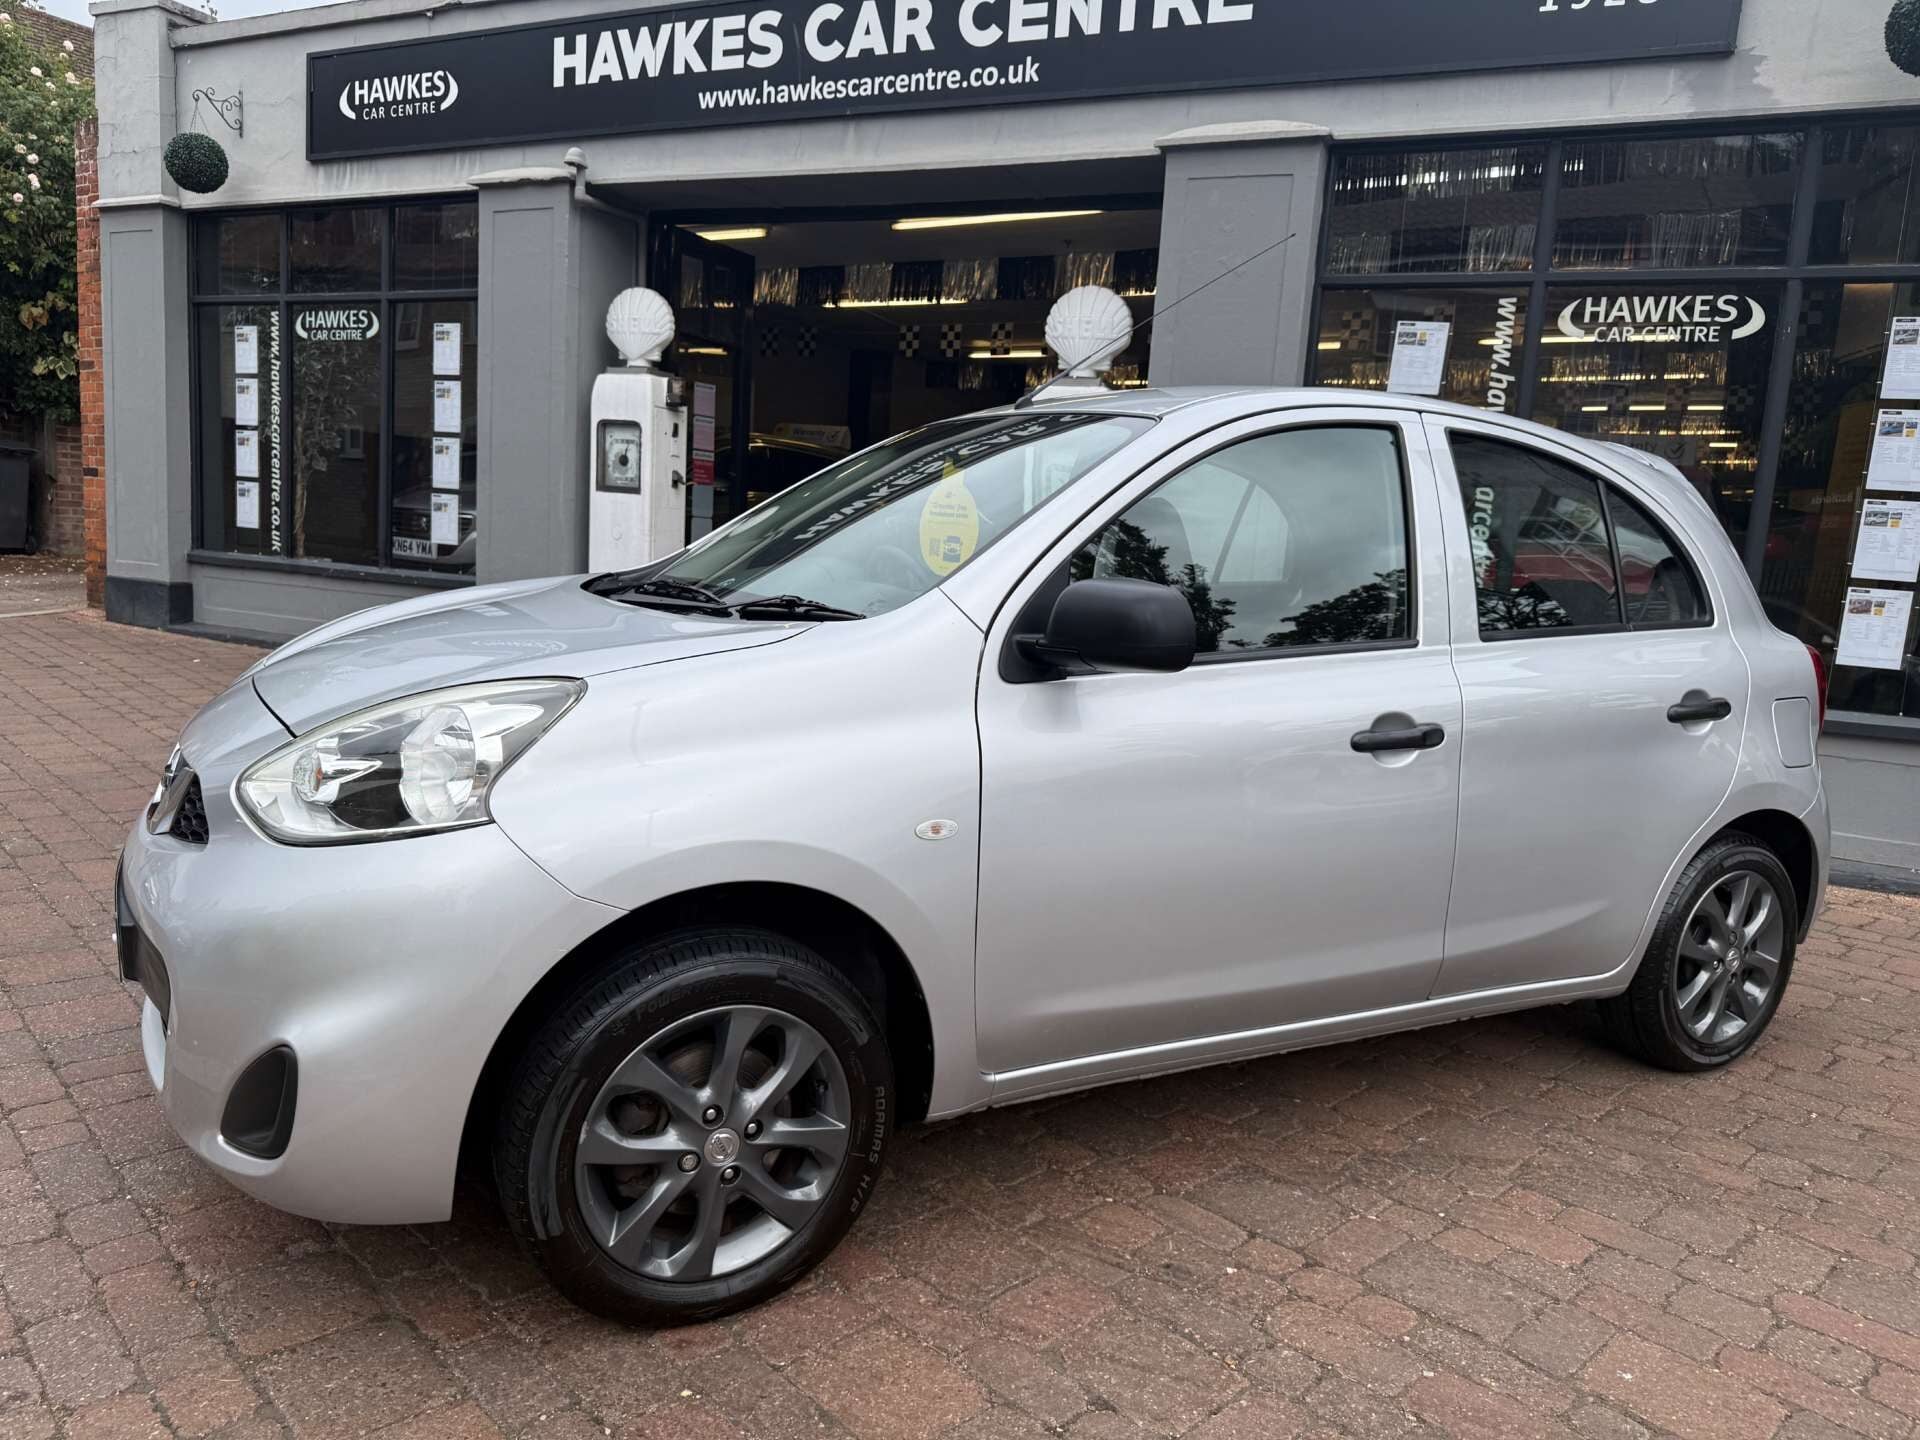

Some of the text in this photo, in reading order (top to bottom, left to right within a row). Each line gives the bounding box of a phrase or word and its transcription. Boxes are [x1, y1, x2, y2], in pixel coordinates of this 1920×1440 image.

[552, 9, 784, 88] HAWKES
[803, 0, 935, 62] CAR
[354, 69, 446, 105] HAWKES
[698, 56, 1040, 110] www.hawkescarcentre.co.uk
[362, 100, 437, 120] CAR CENTRE
[305, 310, 369, 328] HAWKES
[1583, 294, 1739, 323] HAWKES
[311, 329, 363, 341] CAR CENTRE
[1594, 325, 1721, 343] CAR CENTRE
[270, 310, 282, 552] www.hawkescarcentre.co.uk
